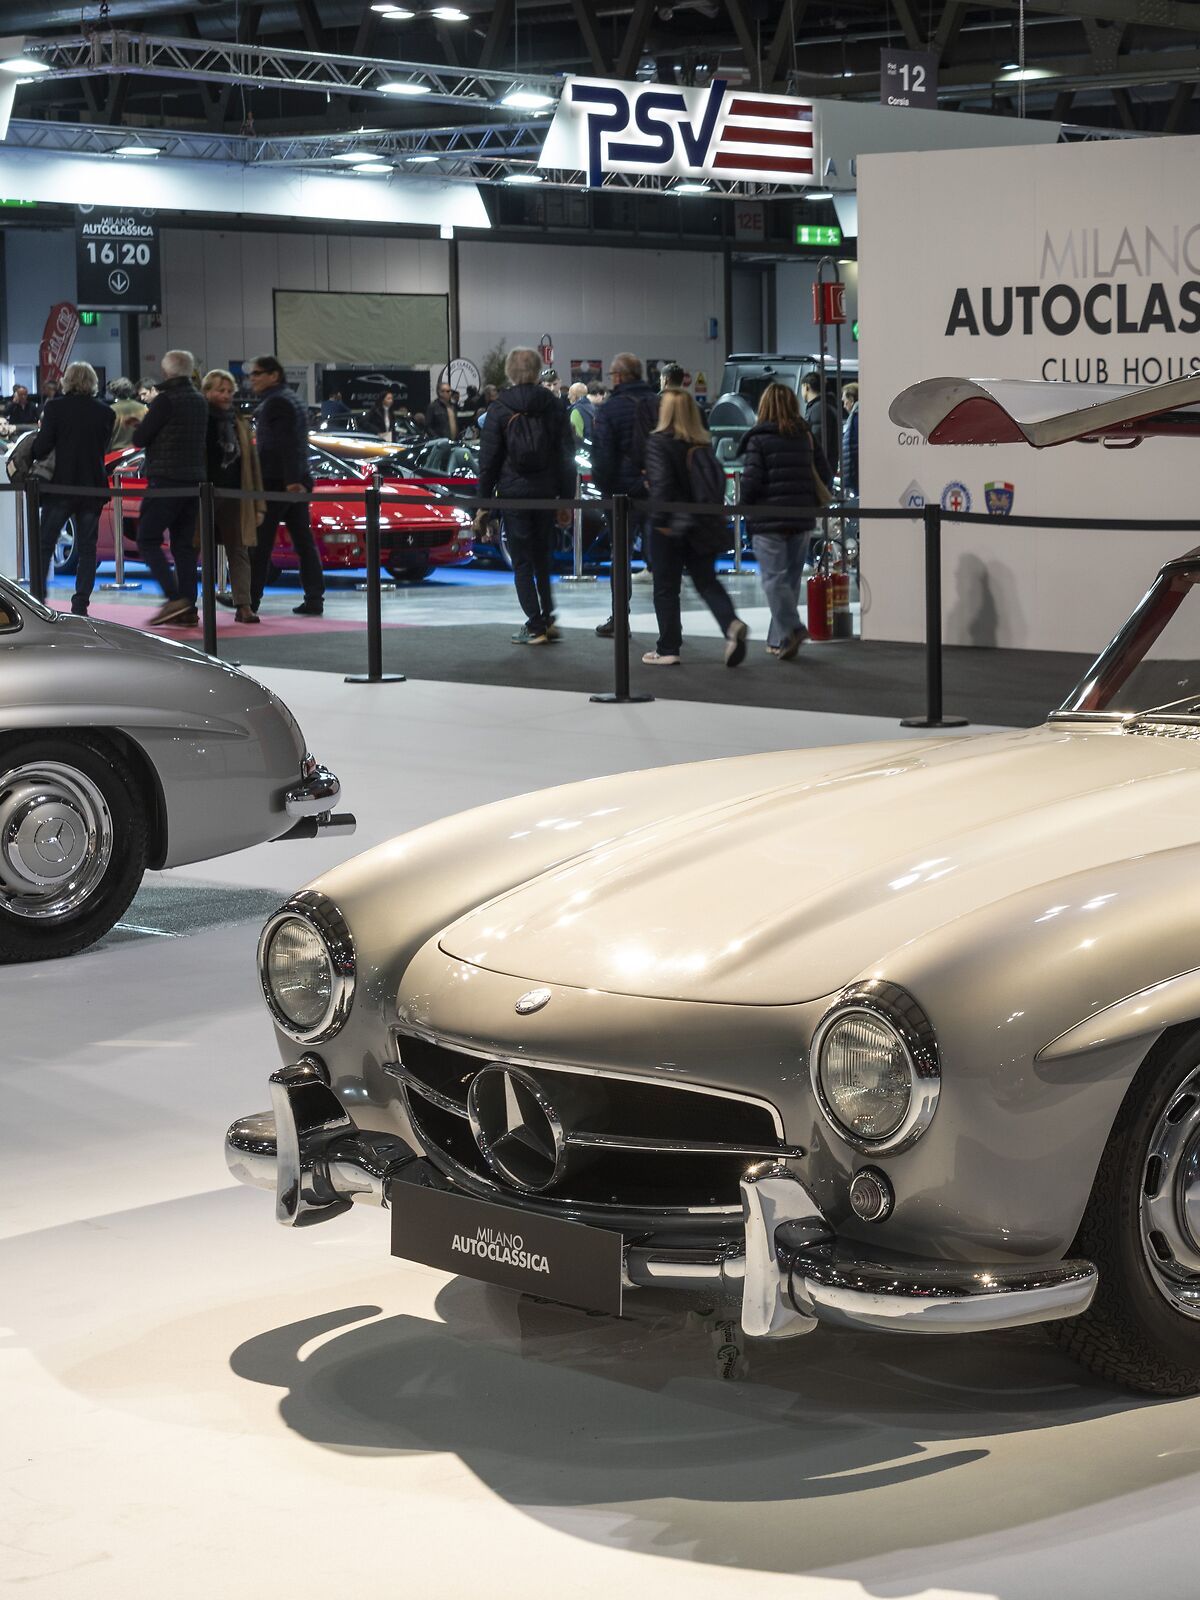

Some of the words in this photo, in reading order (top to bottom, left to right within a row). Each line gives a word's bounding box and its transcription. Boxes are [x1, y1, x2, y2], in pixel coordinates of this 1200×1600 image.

[899, 64, 926, 92] 12
[571, 79, 728, 188] PSV
[82, 224, 154, 236] AUTOCLASSICA
[101, 217, 136, 227] MILANO
[737, 213, 762, 230] 12E
[87, 242, 115, 265] 16
[121, 243, 151, 266] 20
[1042, 358, 1109, 384] CLUB
[898, 432, 920, 446] Con
[476, 1226, 524, 1251] MILANO
[451, 1233, 550, 1274] AUTOCLASSICA
